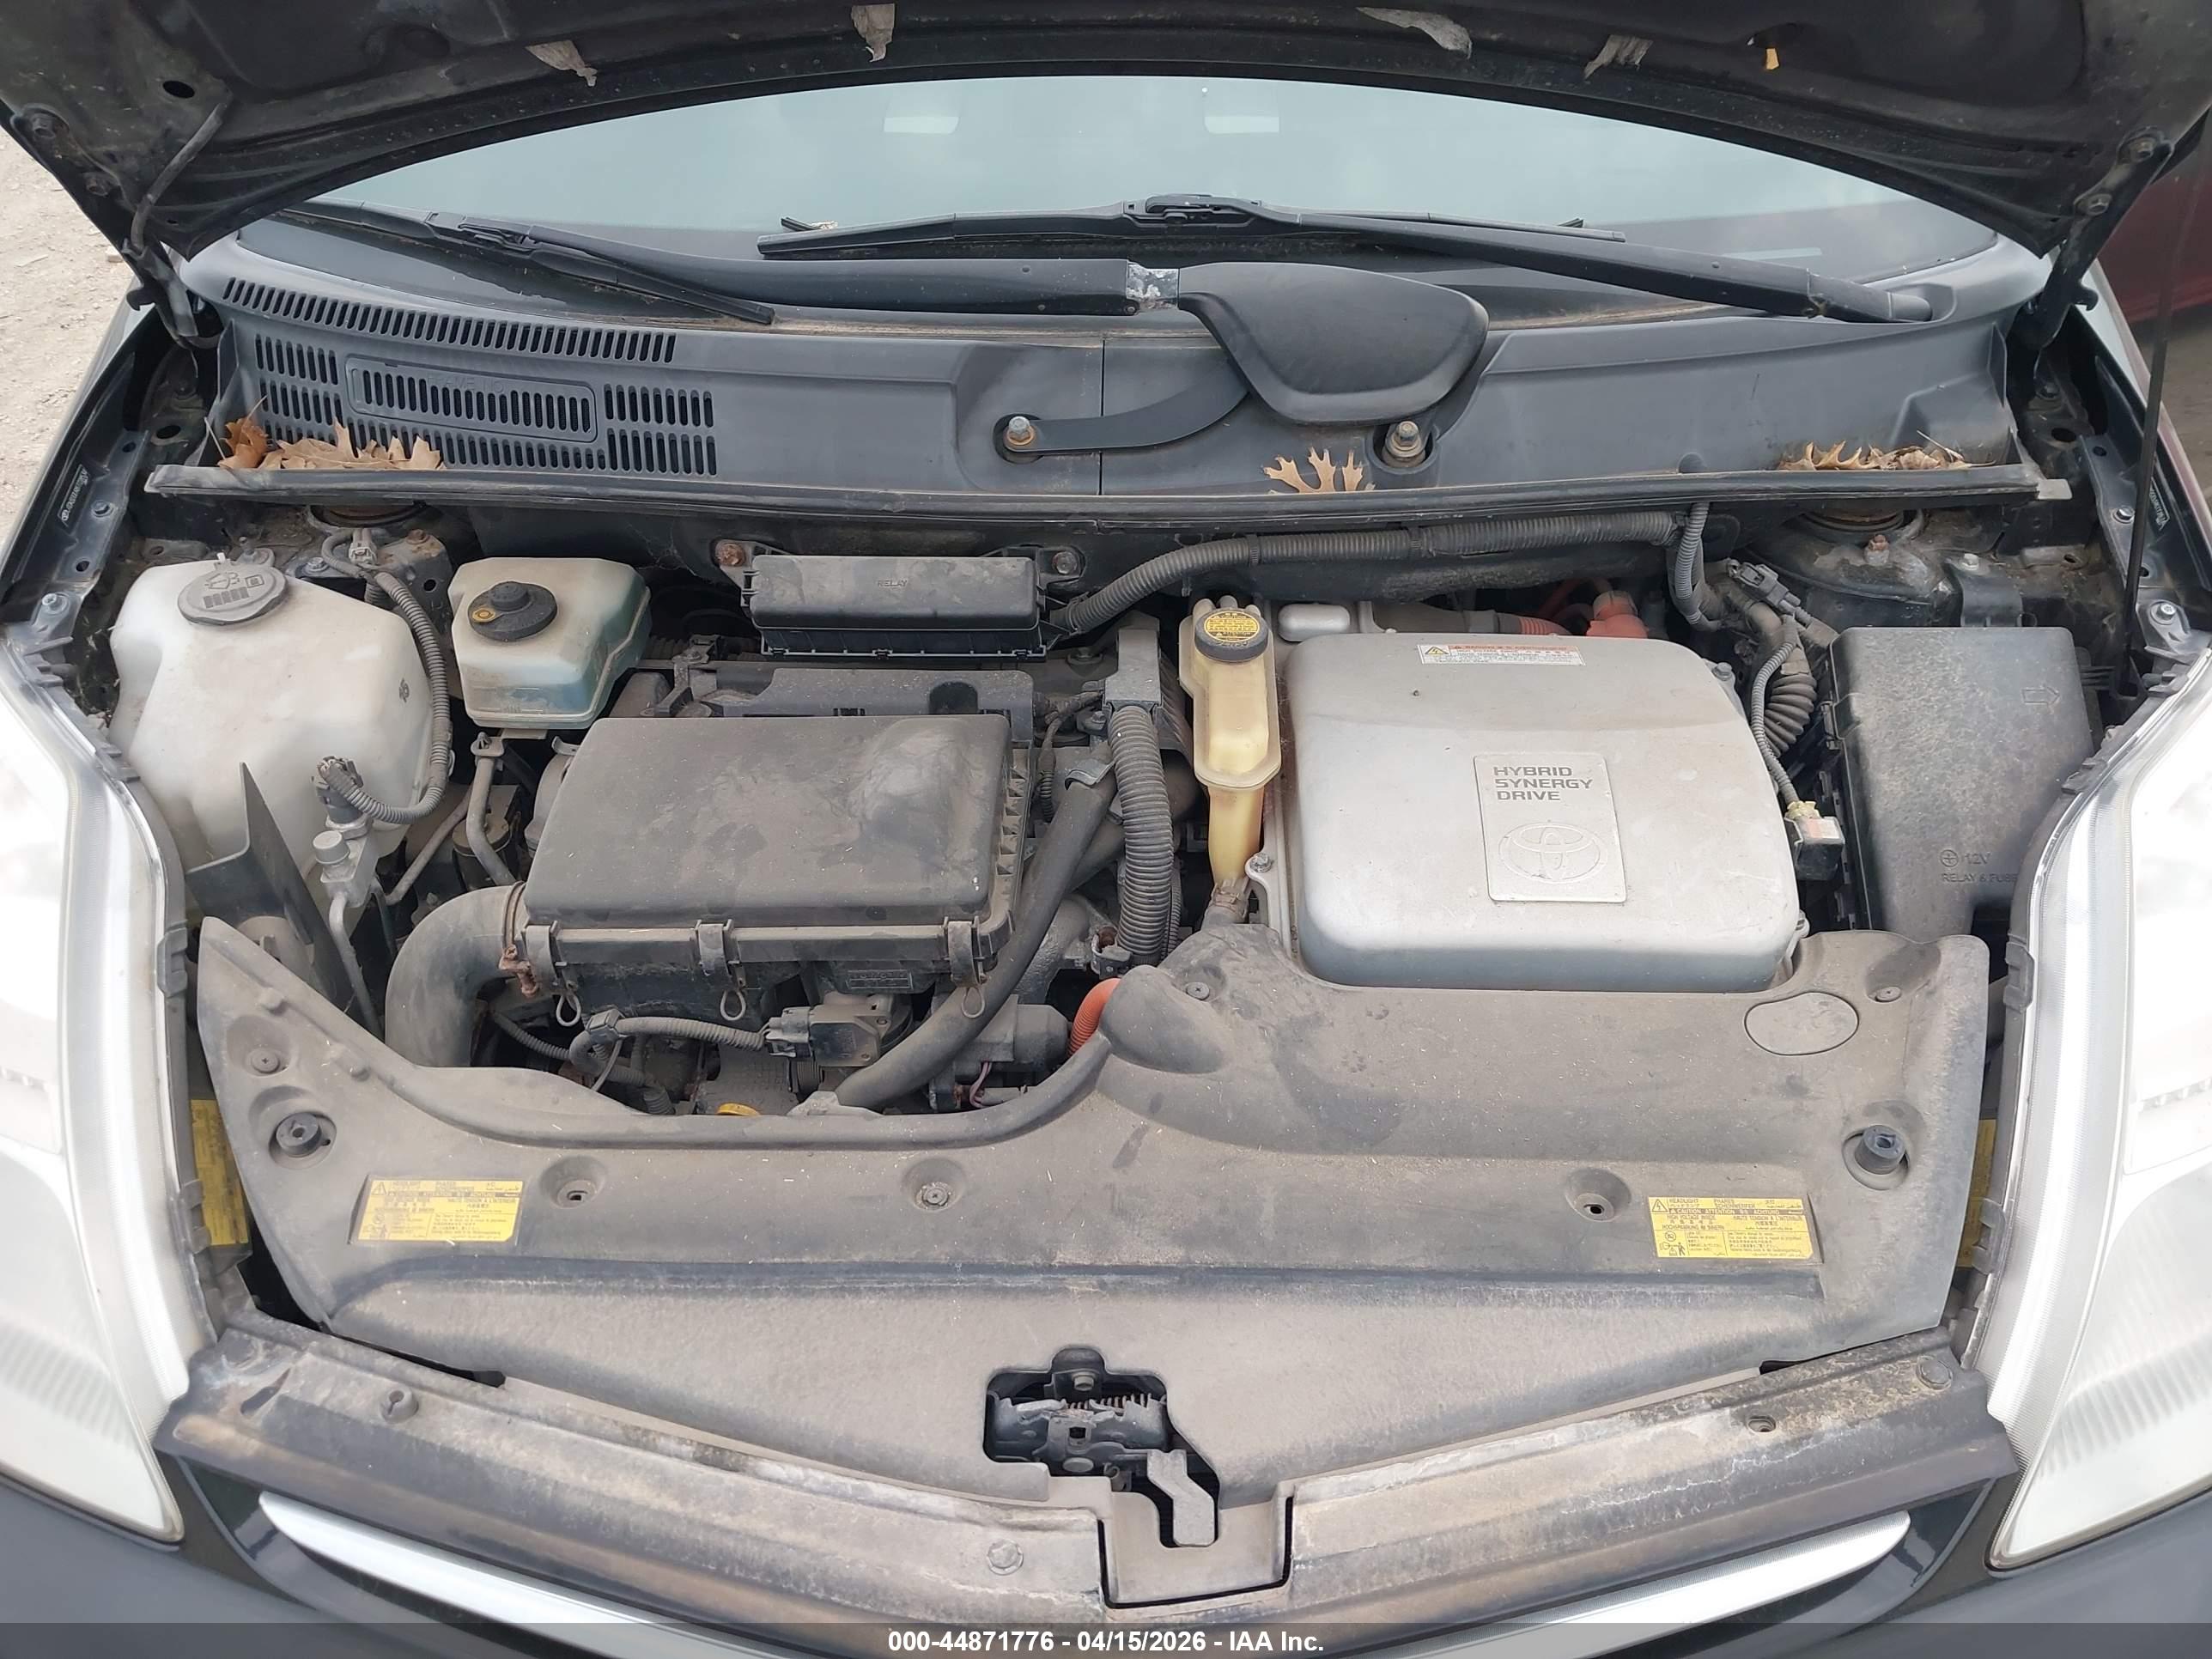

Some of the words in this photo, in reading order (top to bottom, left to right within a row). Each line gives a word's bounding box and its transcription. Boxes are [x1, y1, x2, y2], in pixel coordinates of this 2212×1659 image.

[427, 375, 475, 391] FRAME
[1493, 766, 1572, 776] HYBRID
[1494, 778, 1593, 789] SYNERGY
[1497, 791, 1560, 800] DRIVE
[1964, 852, 1990, 864] 12V
[1942, 872, 1977, 883] RELAY
